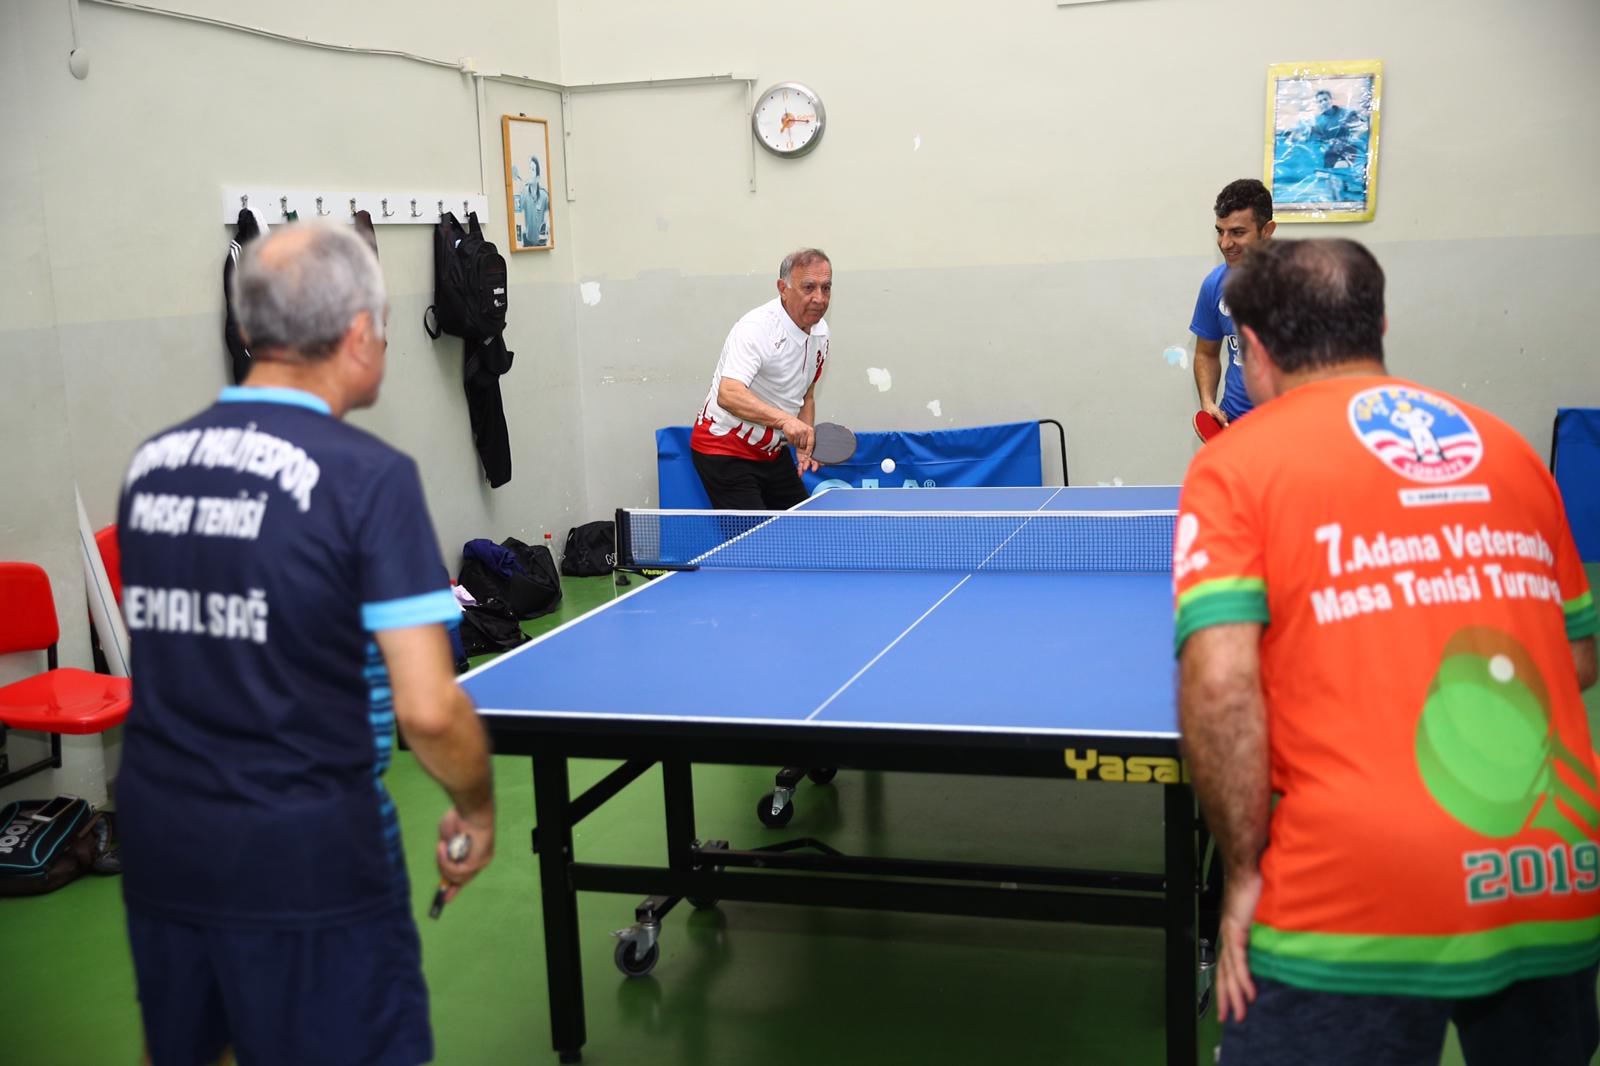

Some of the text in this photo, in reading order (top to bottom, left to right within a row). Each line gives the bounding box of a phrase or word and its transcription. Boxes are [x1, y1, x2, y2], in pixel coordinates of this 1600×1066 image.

[129, 489, 268, 541] MASA TENİSİ
[123, 585, 269, 645] EMAL SAĞ
[1310, 586, 1393, 625] Masa
[1393, 566, 1481, 607] Tenisi
[1463, 841, 1600, 907] 2019
